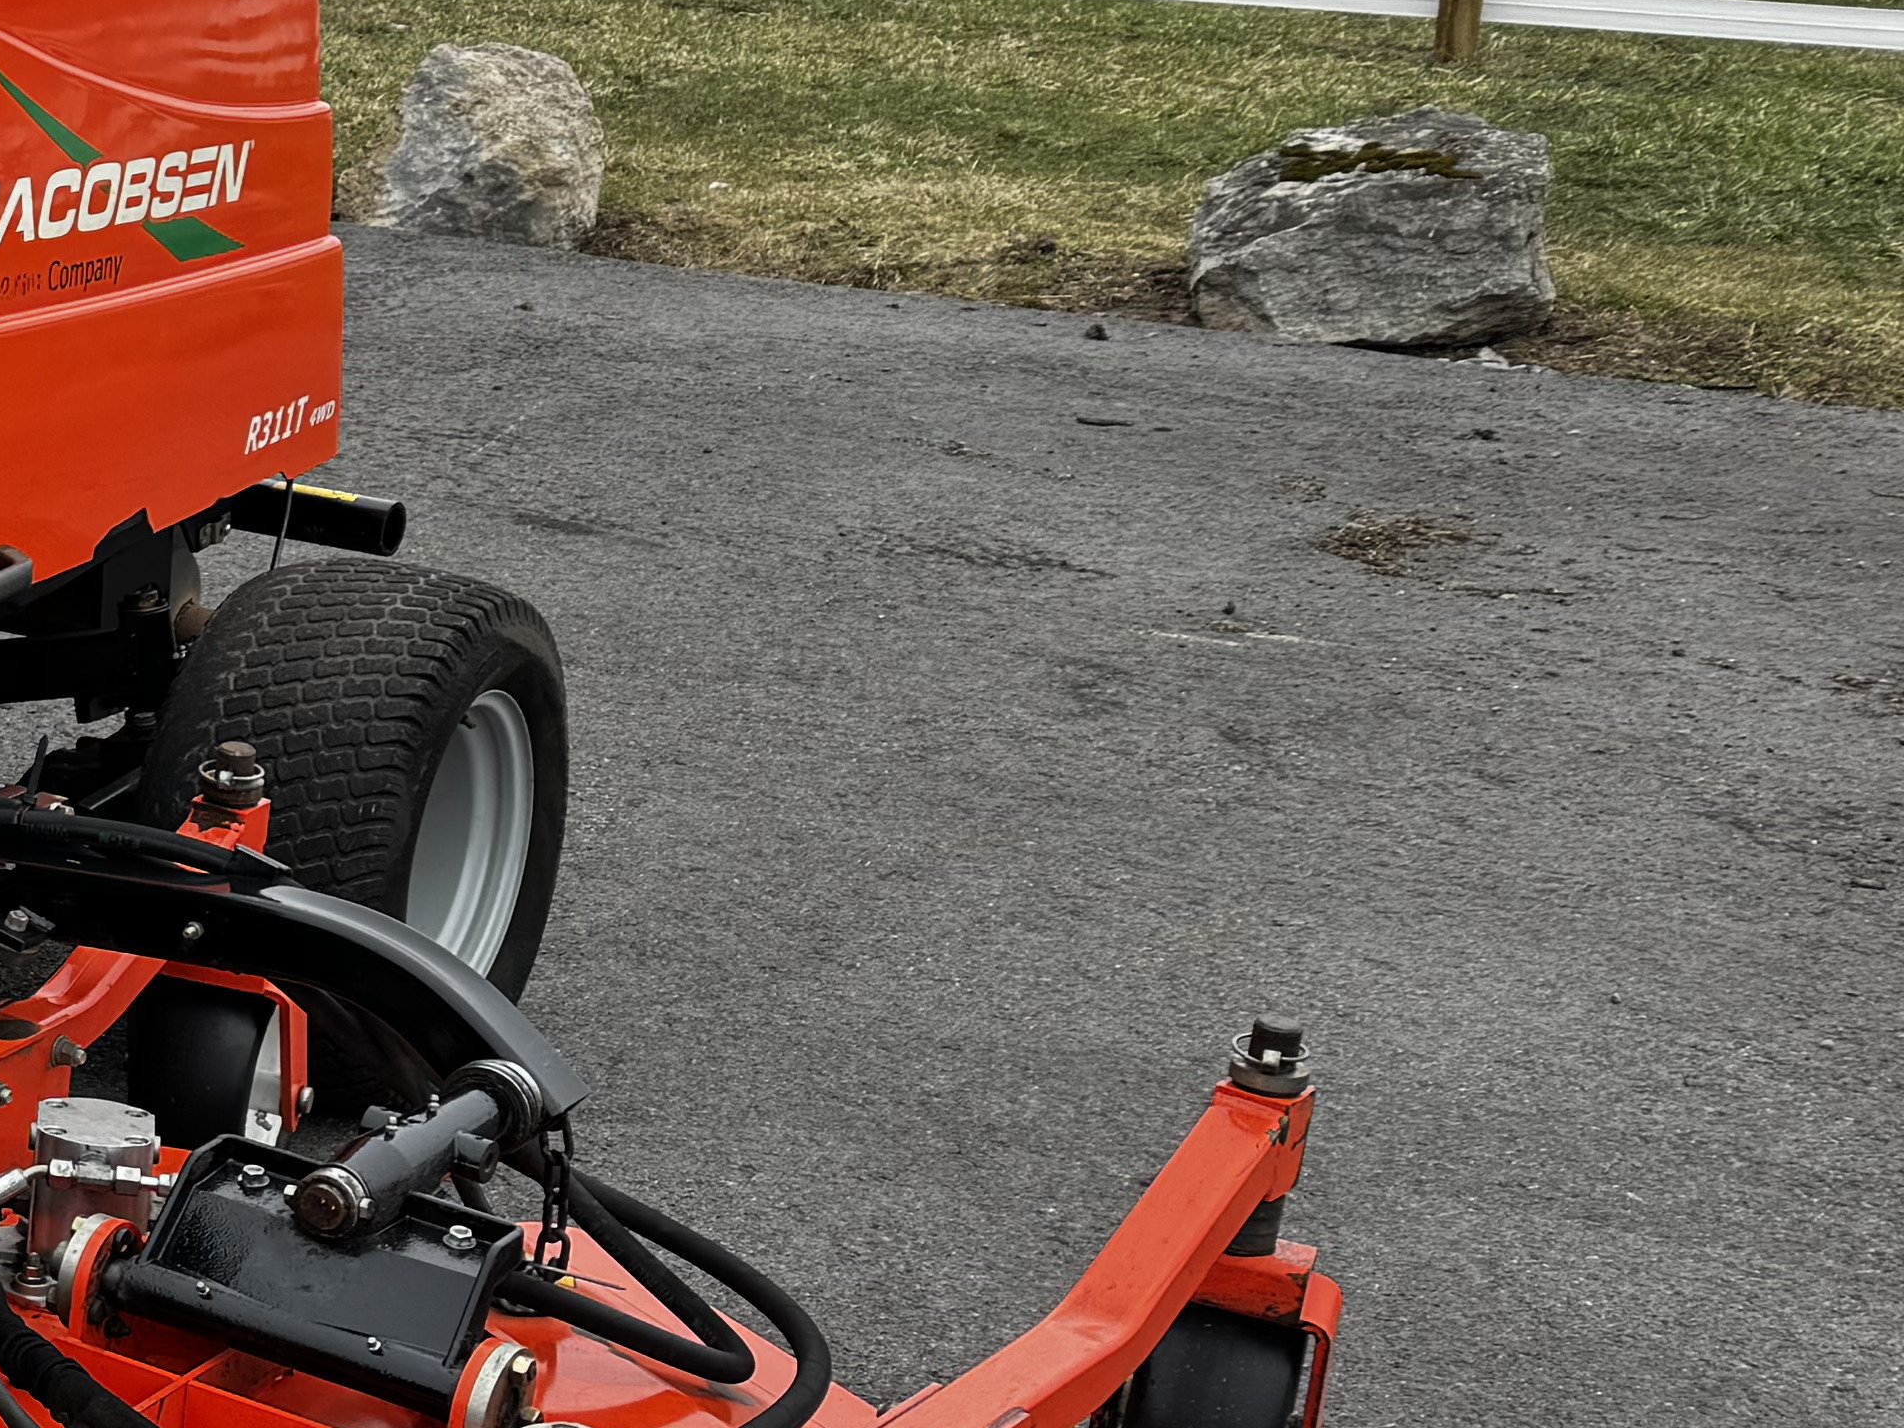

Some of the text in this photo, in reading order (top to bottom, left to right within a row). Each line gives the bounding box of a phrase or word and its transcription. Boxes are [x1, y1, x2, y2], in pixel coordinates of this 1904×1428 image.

[48, 254, 124, 293] Company
[244, 394, 337, 456] R311T 4WD
